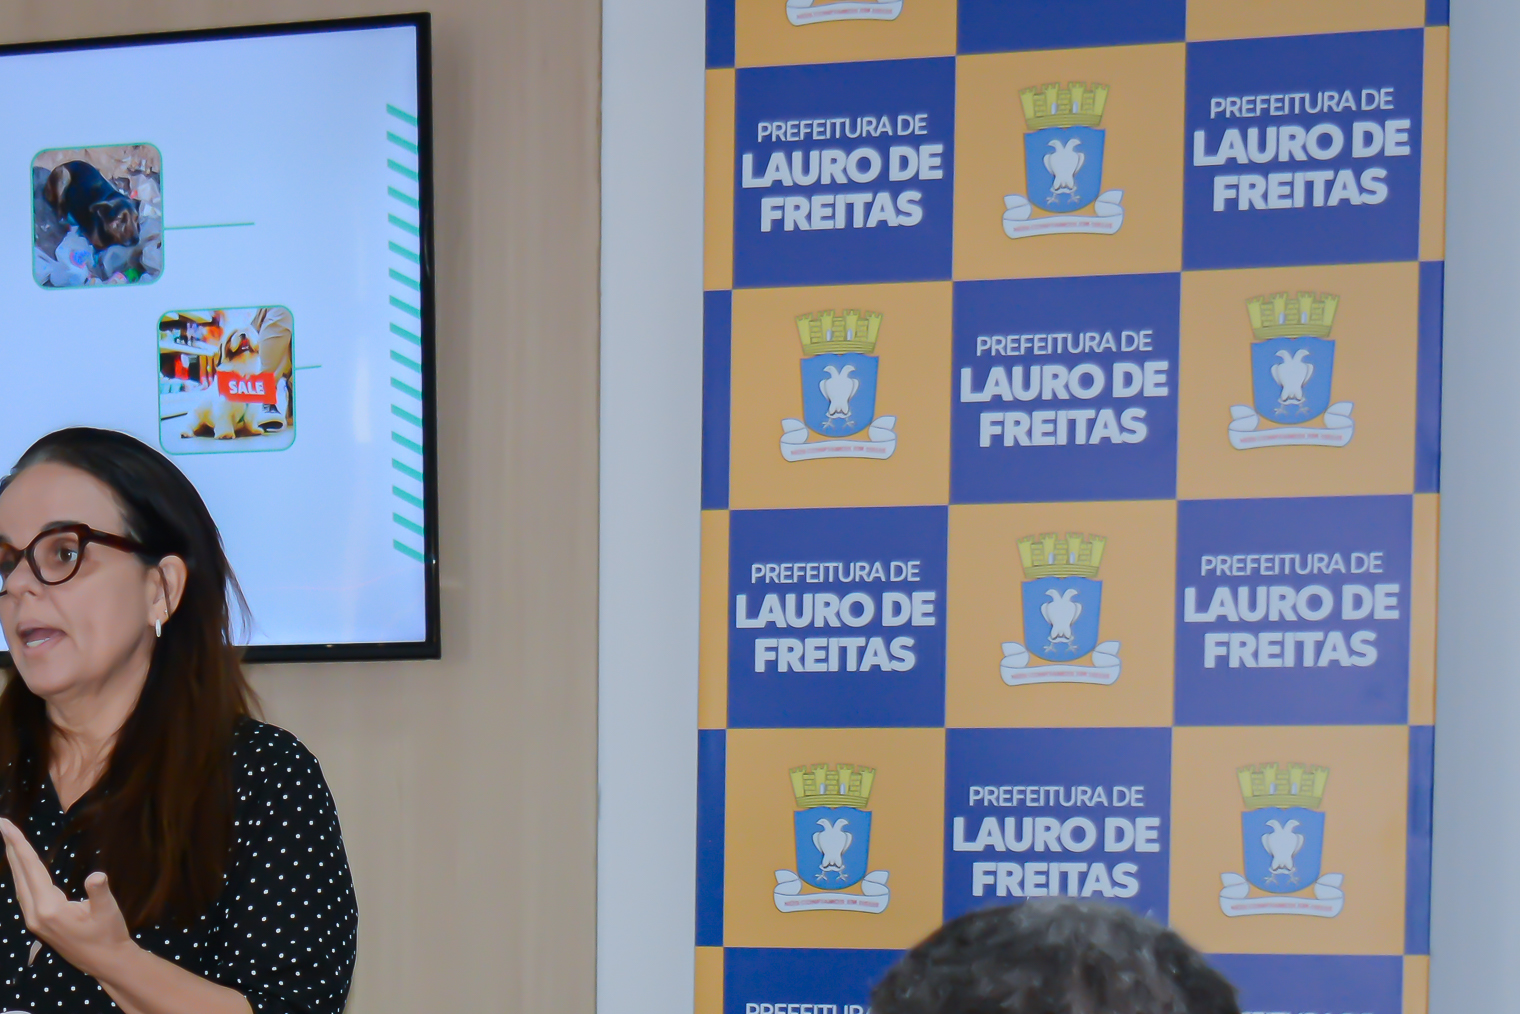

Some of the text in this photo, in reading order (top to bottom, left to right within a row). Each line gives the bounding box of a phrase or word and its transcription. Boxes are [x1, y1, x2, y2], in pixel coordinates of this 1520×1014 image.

[1210, 88, 1395, 119] PREFEITURA DE
[757, 114, 928, 143] PREFEITURA DE
[1193, 119, 1411, 167] LAURO DE
[741, 144, 944, 189] LAURO DE
[1213, 168, 1389, 212] FREITAS
[760, 191, 924, 233] FREITAS
[976, 331, 1153, 357] PREFEITURA DE
[228, 380, 266, 395] SALE
[960, 361, 1169, 403] LAURO DE
[979, 408, 1148, 448] FREITAS
[751, 561, 921, 584] PREFEITURA DE
[1201, 553, 1384, 577] PREFEITURA DE
[735, 592, 937, 629] LAURO DE
[1183, 584, 1400, 623] LAURO DE
[754, 637, 916, 673] FREITAS
[1203, 631, 1379, 669] FREITAS
[969, 786, 1145, 807] PREFEITURA DE
[953, 817, 1162, 853] LAURO DE
[972, 862, 1140, 899] FREITAS
